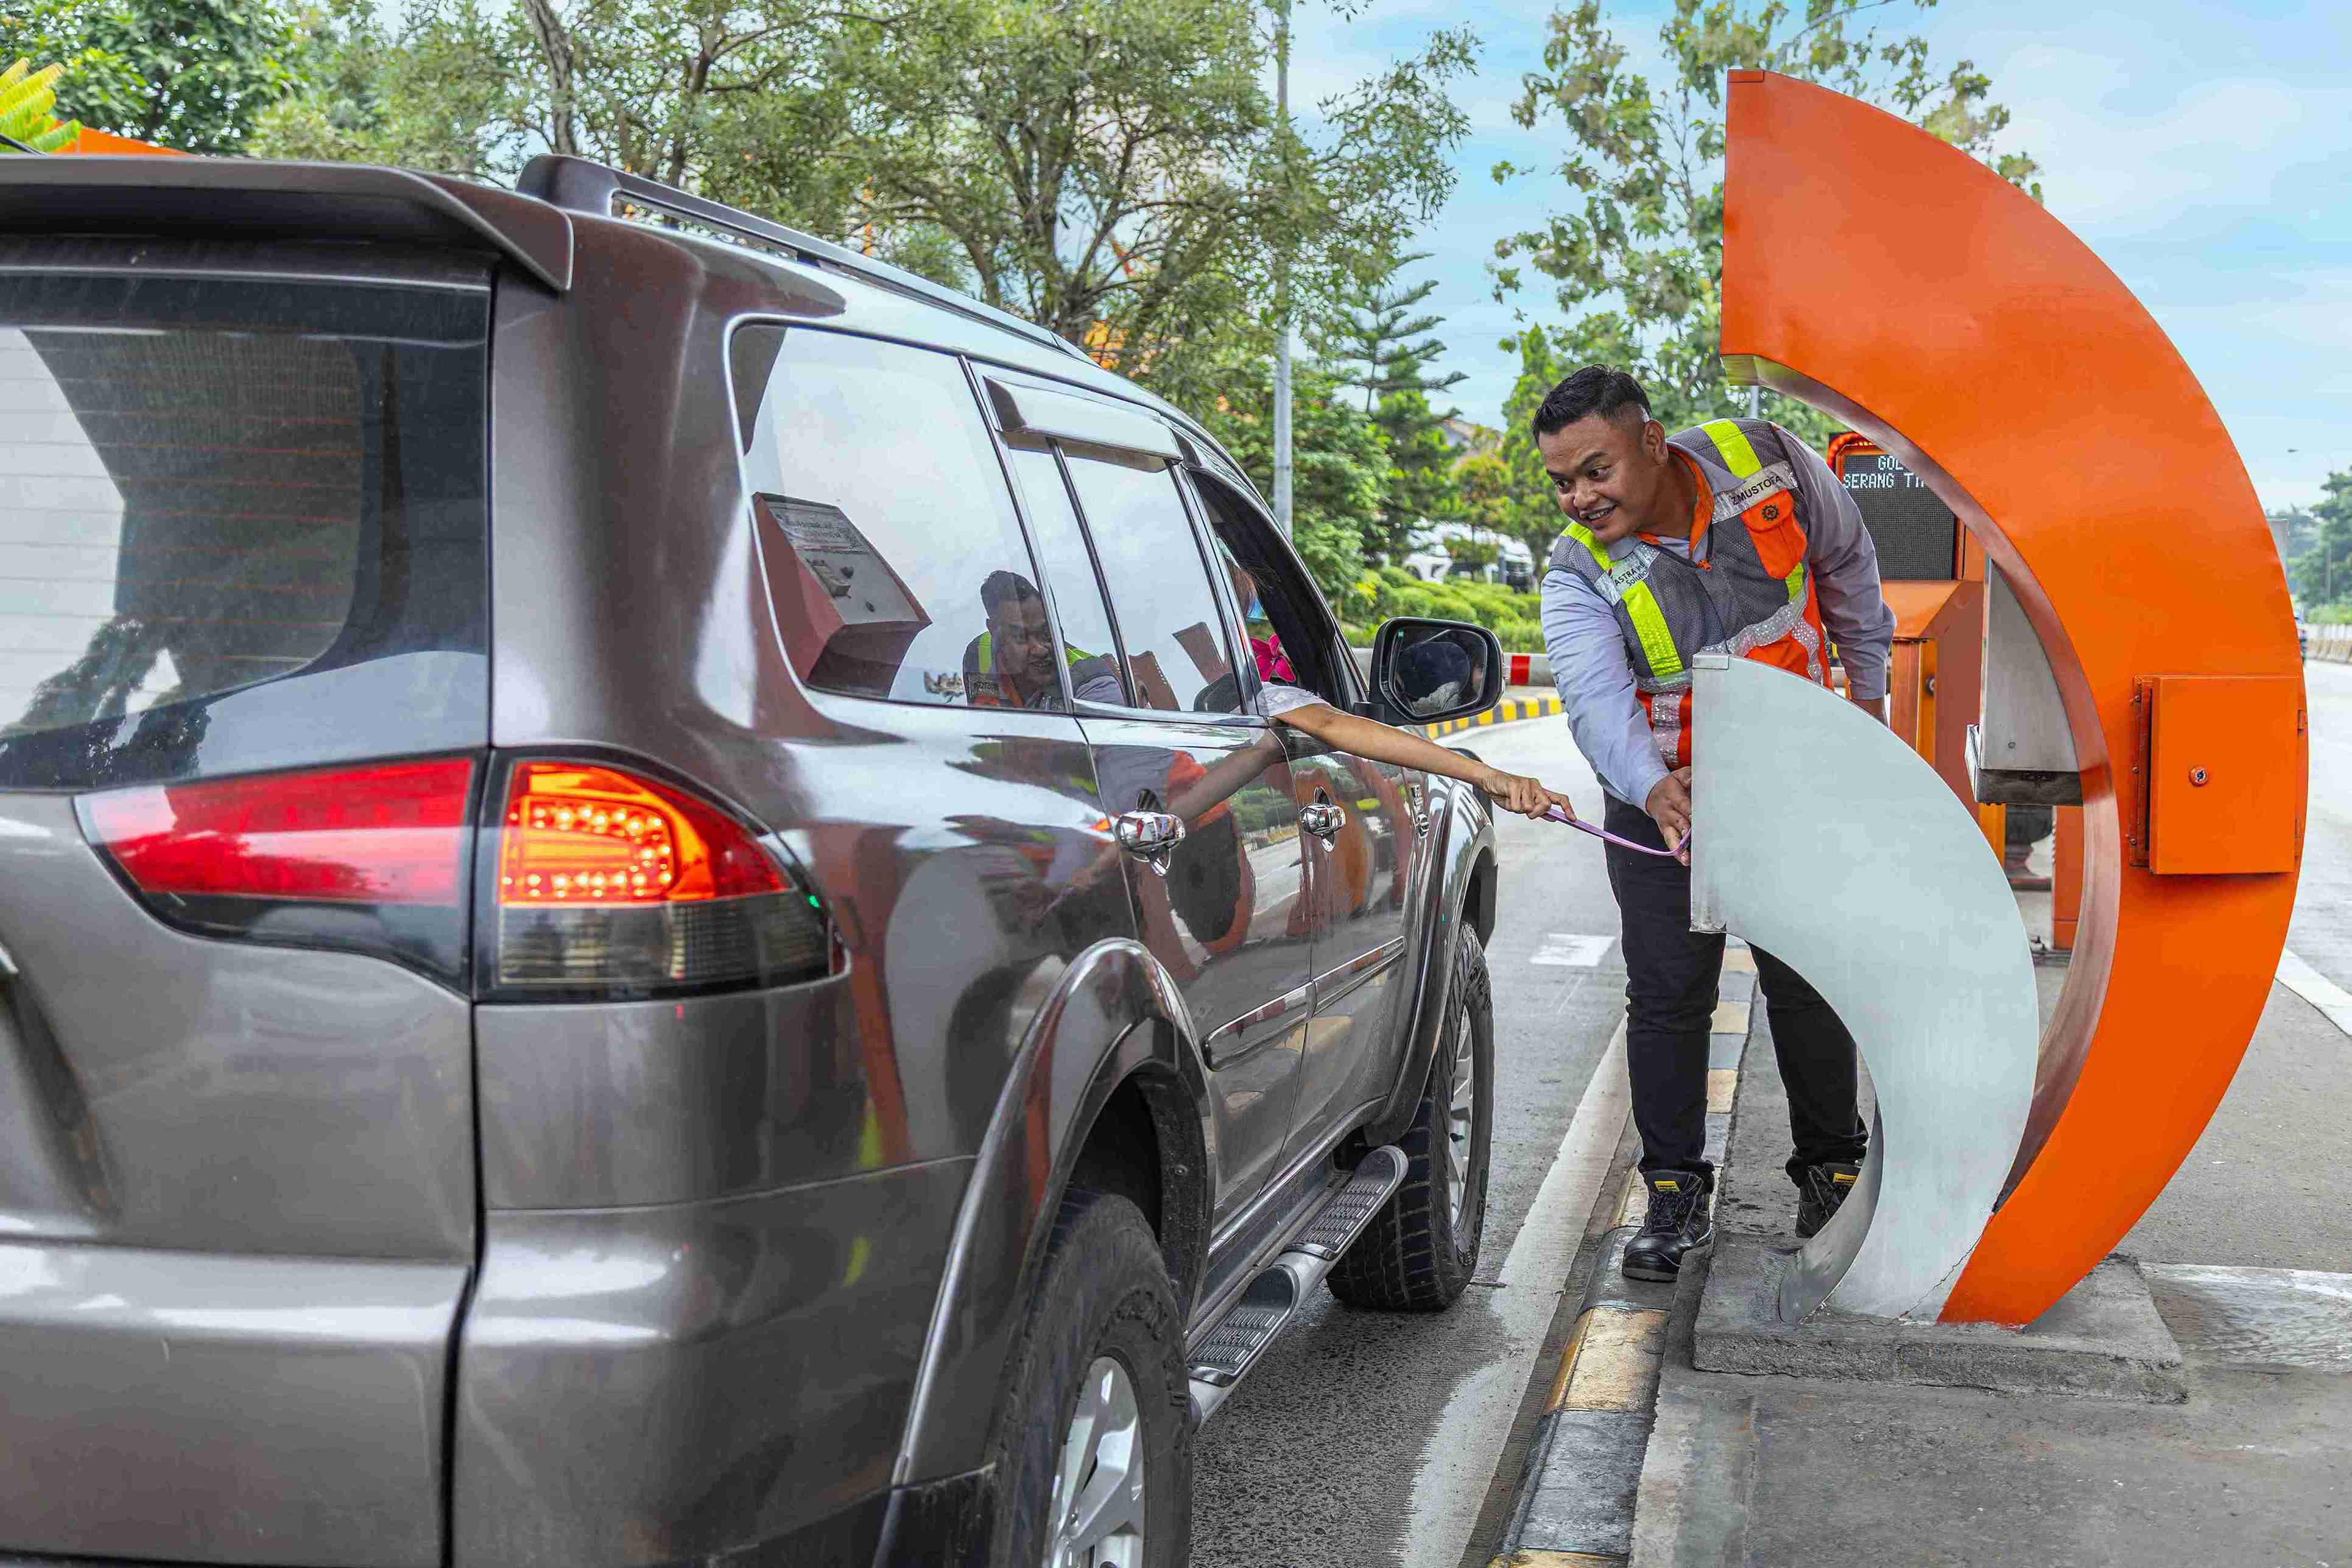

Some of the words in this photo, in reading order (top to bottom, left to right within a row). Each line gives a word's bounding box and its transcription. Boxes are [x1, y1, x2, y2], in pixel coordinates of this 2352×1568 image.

[1843, 473, 1894, 488] SERANG
[1903, 473, 1924, 488] TI
[1614, 568, 1638, 585] ASTRA
